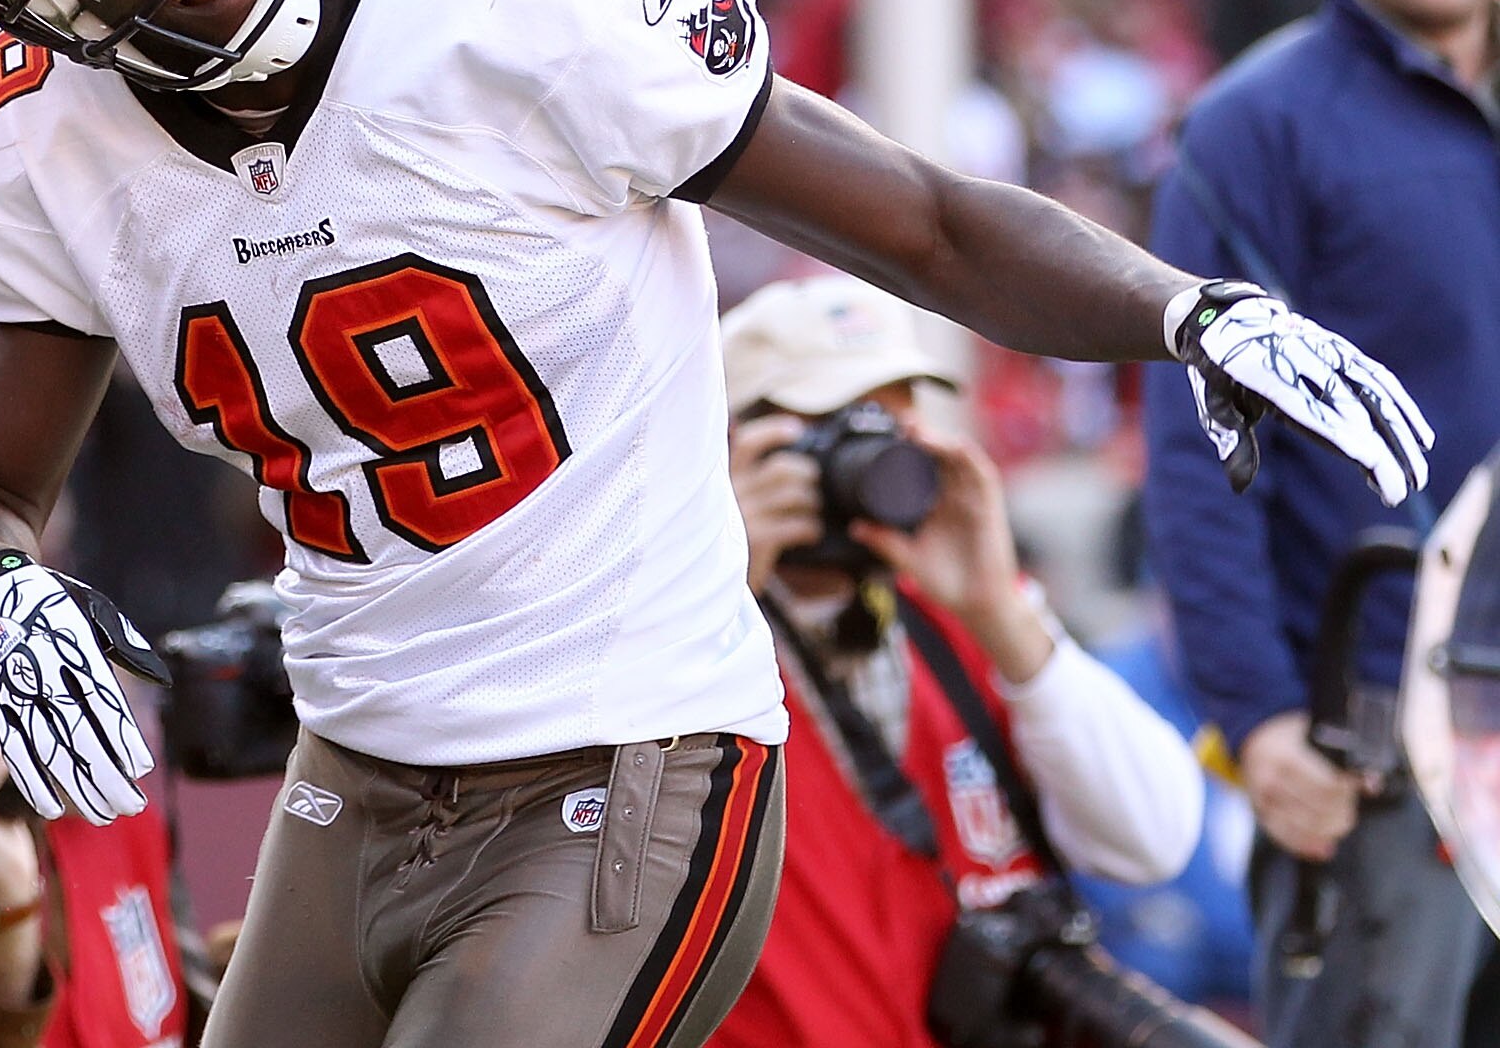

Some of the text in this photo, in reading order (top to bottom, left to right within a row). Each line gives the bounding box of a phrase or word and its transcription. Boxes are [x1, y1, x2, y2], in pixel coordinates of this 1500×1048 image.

[254, 173, 276, 191] NFL
[174, 251, 572, 565] 19
[573, 810, 596, 823] NFL
